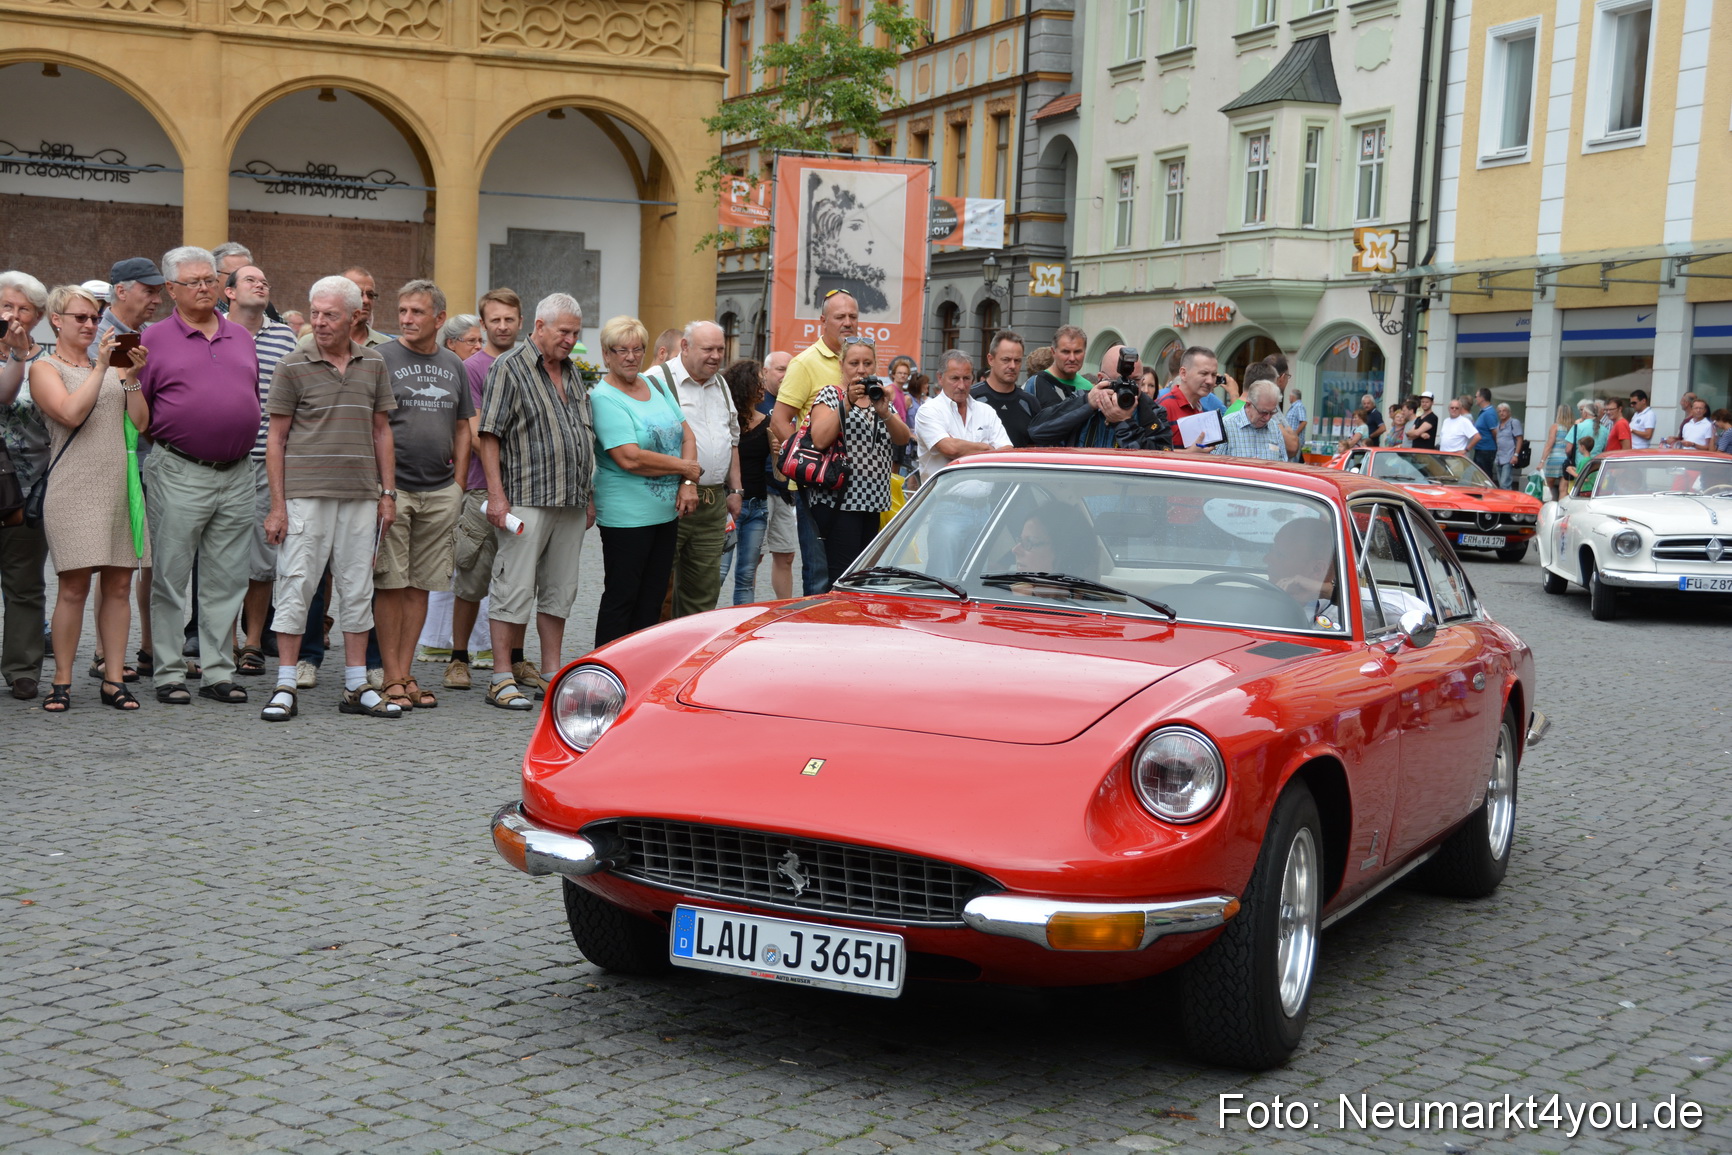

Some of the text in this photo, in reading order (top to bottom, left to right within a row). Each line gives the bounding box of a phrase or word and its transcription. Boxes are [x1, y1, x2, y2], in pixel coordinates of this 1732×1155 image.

[1369, 241, 1387, 259] M
[1041, 273, 1056, 287] M
[1186, 302, 1231, 323] Müller
[804, 324, 890, 341] PISSO
[395, 364, 454, 381] GOLD COAST
[402, 399, 454, 409] THE PARADISE TOUR
[1463, 535, 1478, 545] ERH
[1686, 578, 1702, 589] FÜ
[680, 937, 688, 949] D
[696, 916, 757, 962] LAU
[811, 934, 896, 982] 365H
